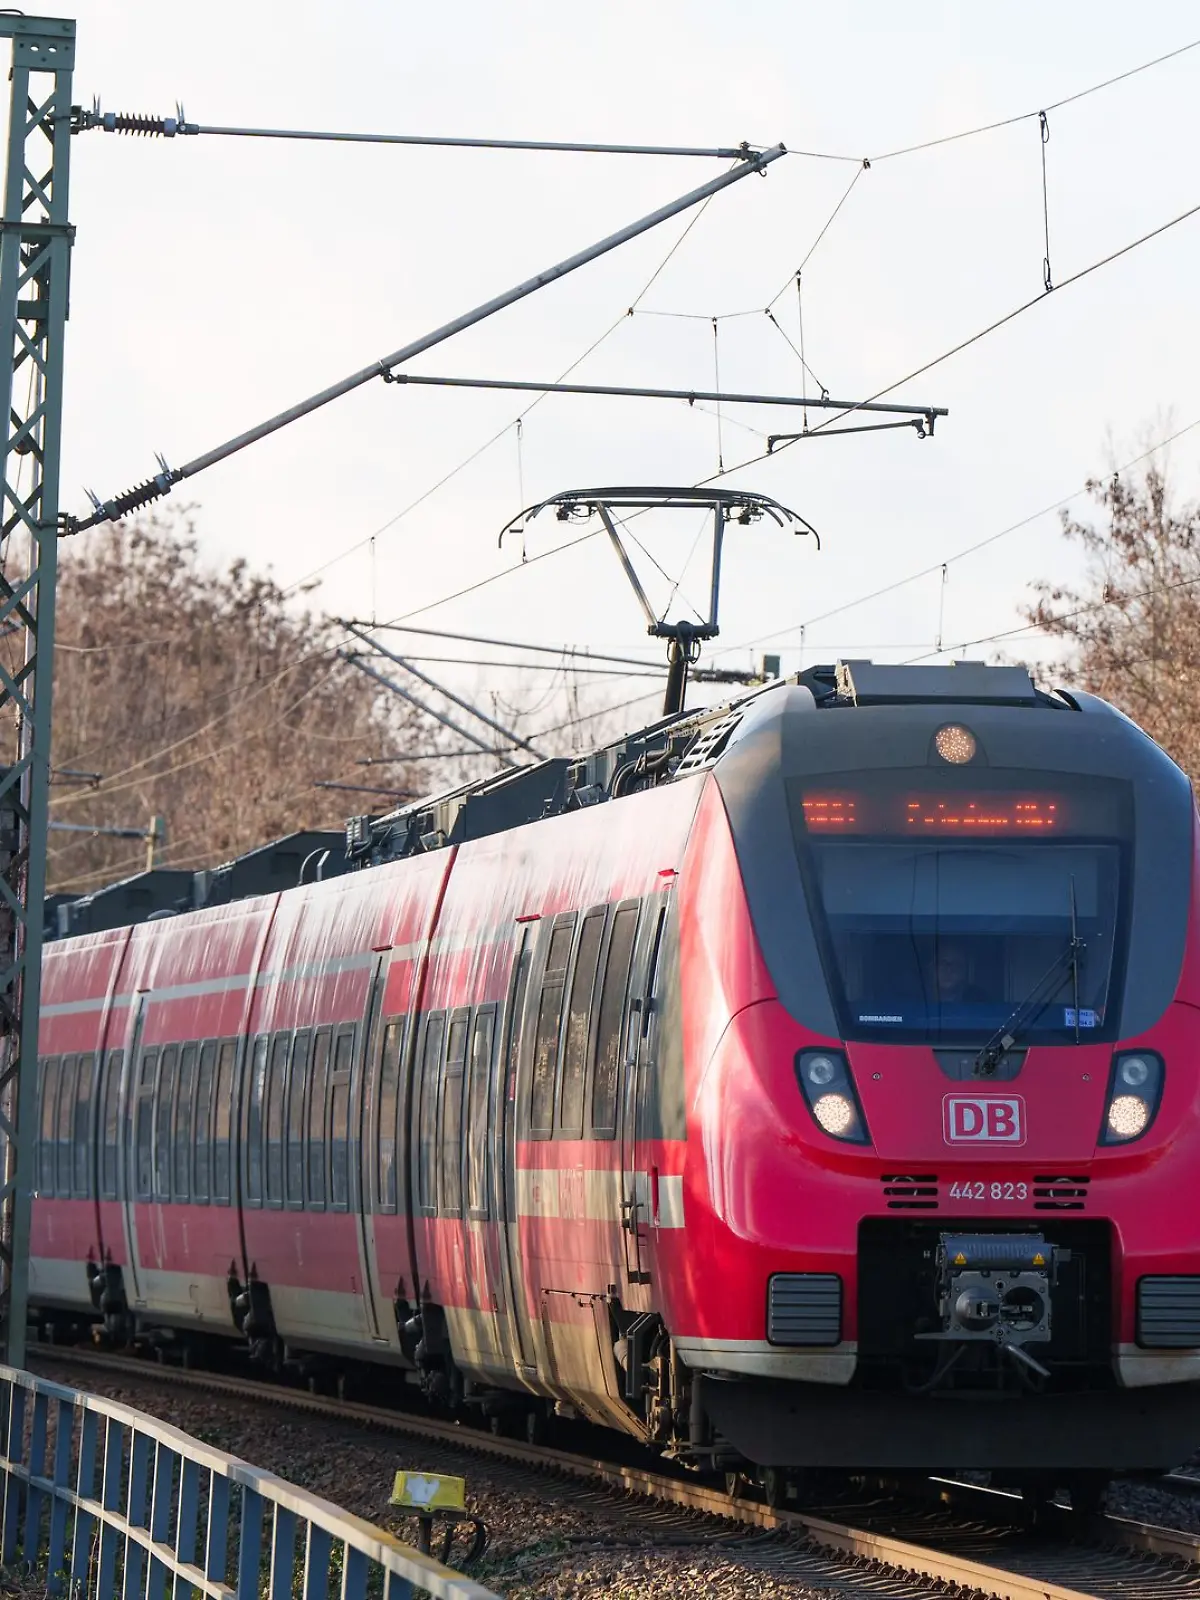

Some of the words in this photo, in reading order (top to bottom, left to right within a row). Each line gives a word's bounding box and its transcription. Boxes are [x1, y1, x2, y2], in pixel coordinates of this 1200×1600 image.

[953, 1102, 1016, 1137] DB
[949, 1182, 985, 1200] 442
[990, 1183, 1028, 1200] 823
